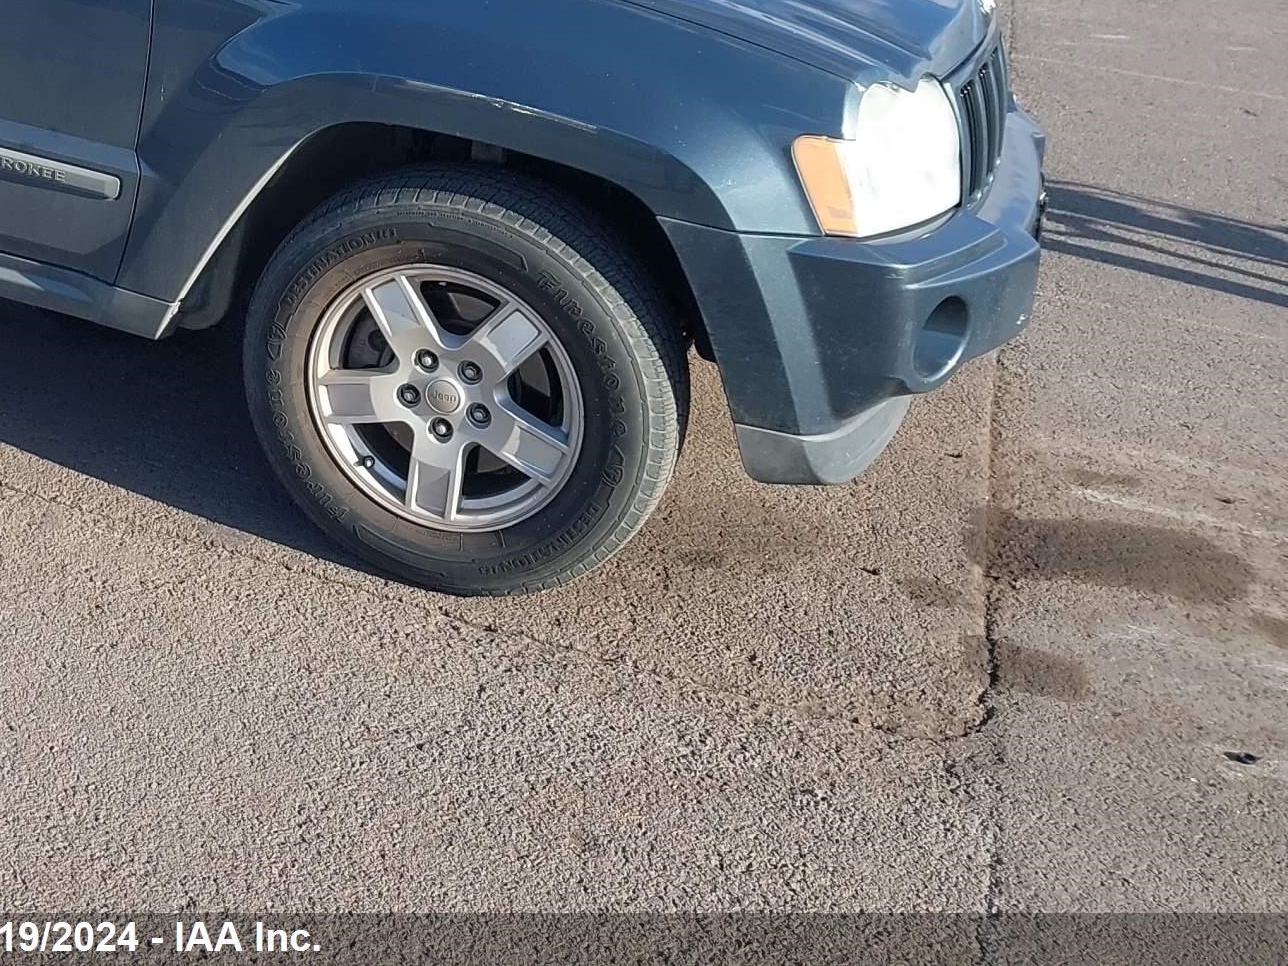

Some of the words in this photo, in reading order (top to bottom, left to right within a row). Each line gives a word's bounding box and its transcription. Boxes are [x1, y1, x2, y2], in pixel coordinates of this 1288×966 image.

[431, 389, 457, 404] Jeep
[535, 269, 628, 439] Firestone
[265, 367, 350, 523] Firestone
